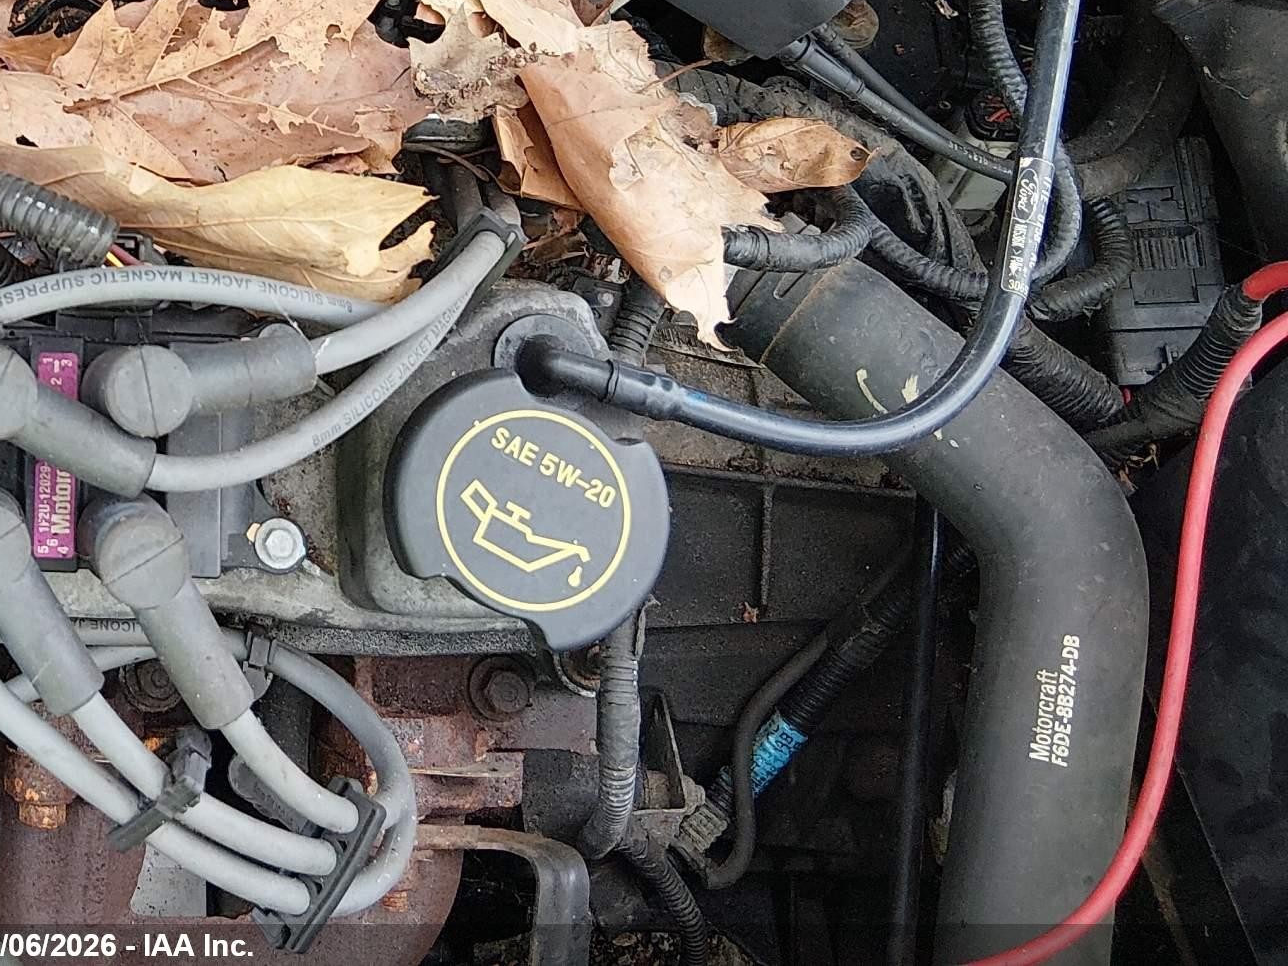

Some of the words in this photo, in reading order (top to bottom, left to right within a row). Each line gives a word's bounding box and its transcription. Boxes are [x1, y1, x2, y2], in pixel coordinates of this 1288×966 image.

[1017, 178, 1035, 214] Ford
[92, 269, 183, 285] MAGNETIC
[188, 271, 253, 291] JACKET
[258, 280, 324, 306] SILICONE
[342, 374, 398, 426] SILICONE
[398, 334, 436, 380] JACKET
[491, 426, 540, 467] SAE
[539, 452, 616, 508] 5W-20
[51, 468, 72, 534] Motor
[37, 545, 50, 554] 5
[46, 538, 59, 547] 6
[57, 545, 70, 554] 4
[1029, 669, 1059, 762] Motorcraft
[1052, 634, 1081, 768] F6DE-8B274-DB
